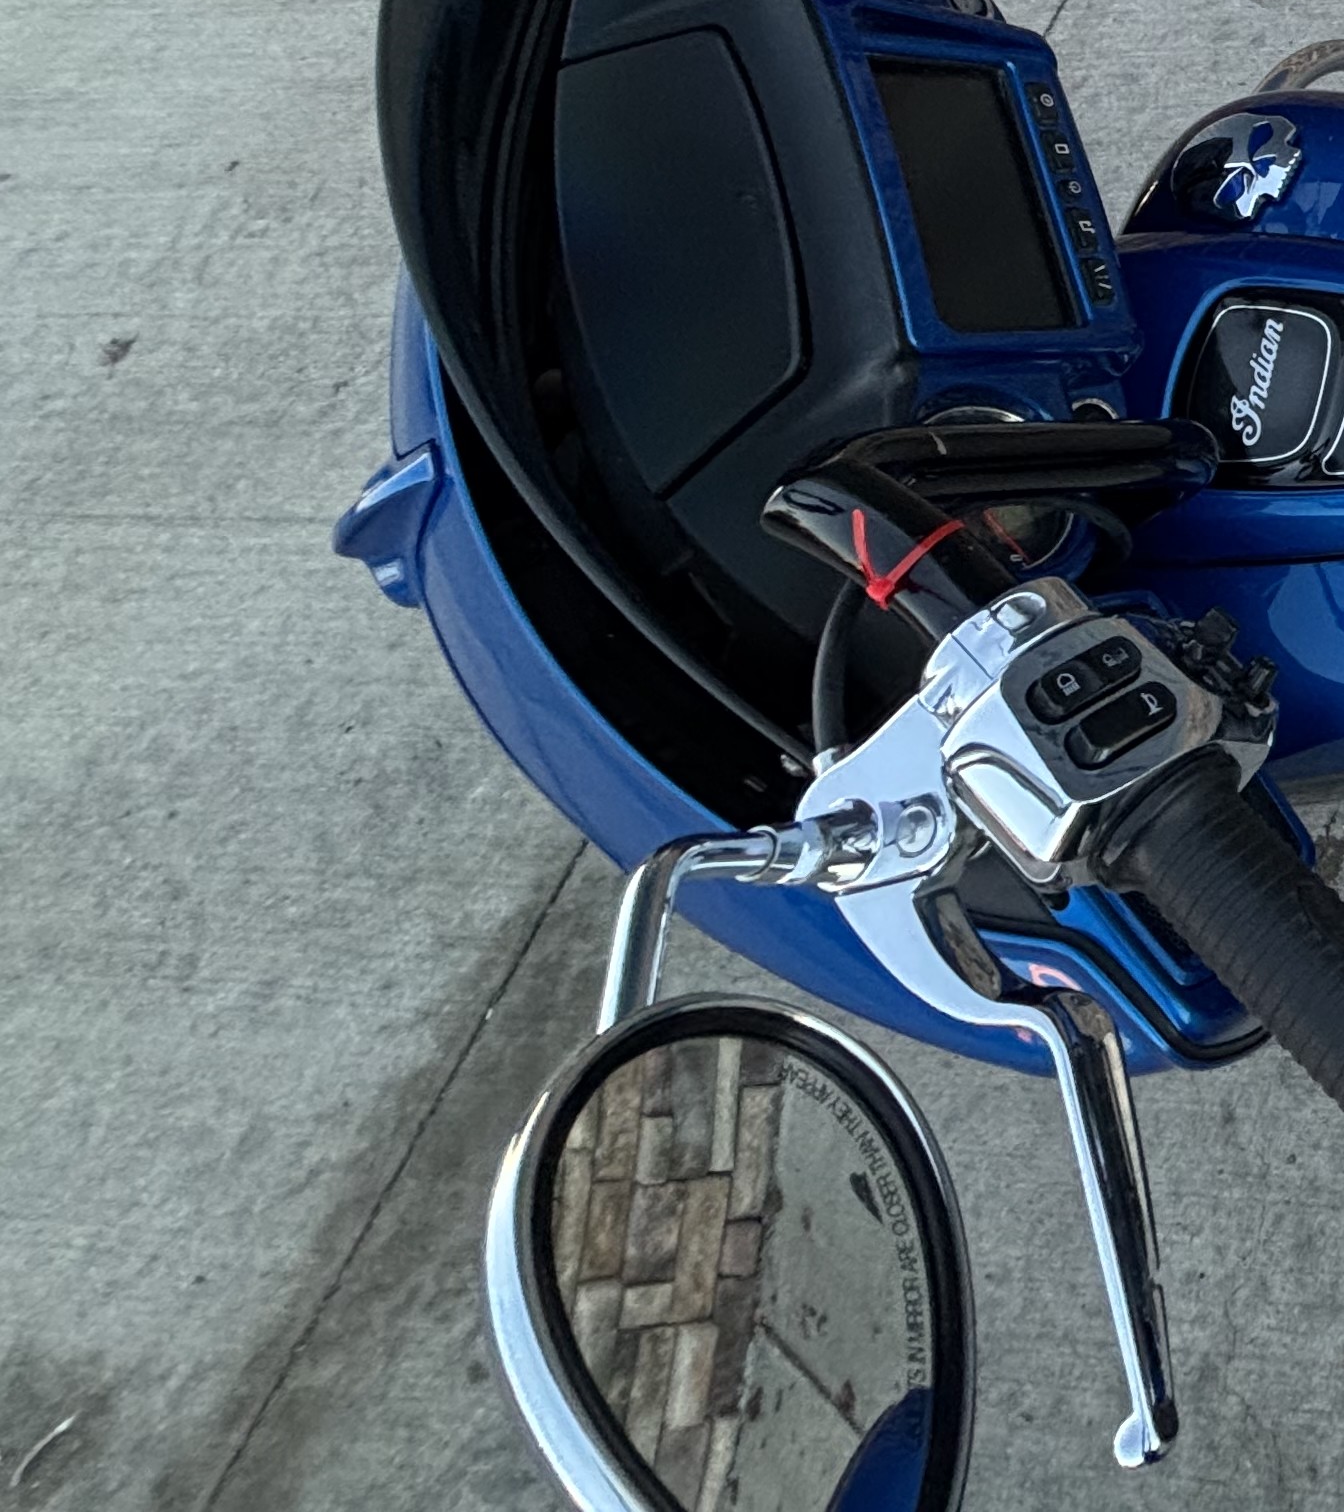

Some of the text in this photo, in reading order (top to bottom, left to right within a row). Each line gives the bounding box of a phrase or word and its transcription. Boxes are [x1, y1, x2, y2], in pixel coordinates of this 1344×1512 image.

[1230, 318, 1284, 446] Indian
[779, 1062, 831, 1104] APPEAR
[827, 1096, 863, 1136] THEY
[856, 1131, 888, 1175] THAN
[876, 1172, 910, 1237] CLOSER
[896, 1239, 918, 1272] ARE
[902, 1276, 927, 1345] MIRROR
[907, 1346, 927, 1366] IN
